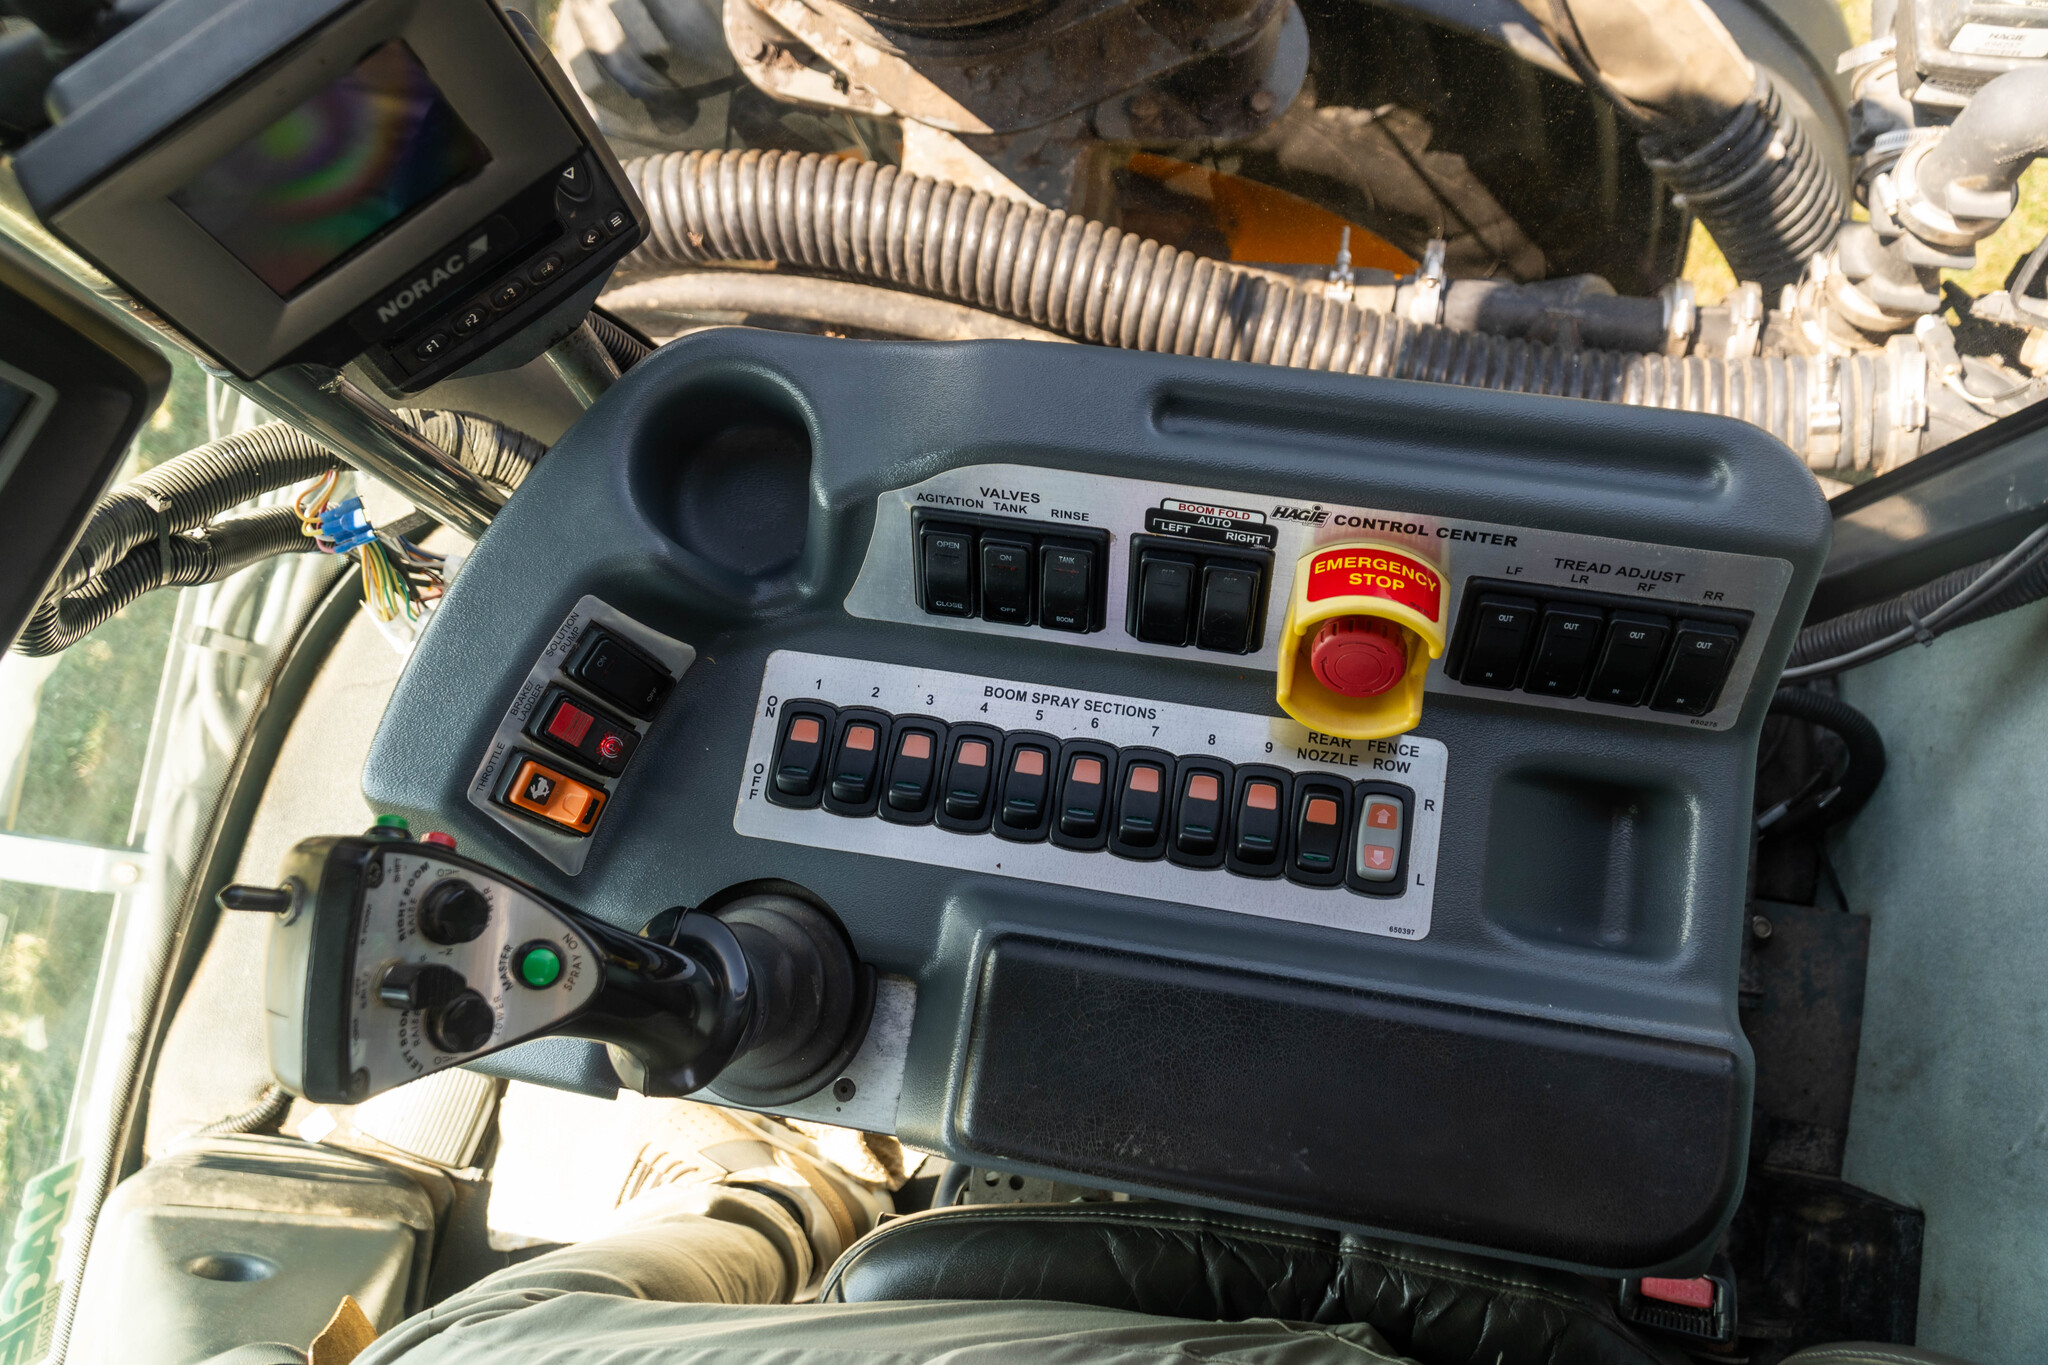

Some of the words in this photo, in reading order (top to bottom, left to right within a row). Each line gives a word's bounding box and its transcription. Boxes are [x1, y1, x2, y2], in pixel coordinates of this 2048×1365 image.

[541, 262, 554, 277] F4
[376, 254, 466, 324] NORAC
[464, 313, 479, 327] F2
[425, 339, 440, 353] F1
[916, 492, 984, 509] AGITATION
[979, 486, 1041, 504] VALVES
[993, 501, 1028, 515] TANK
[1178, 503, 1215, 516] BOOM
[1218, 508, 1251, 521] FOLD
[1050, 509, 1090, 522] RINSE
[1197, 515, 1232, 529] AUTO
[1161, 522, 1191, 535] LEFT
[1334, 514, 1429, 537] CONTROL
[1436, 526, 1518, 548] CENTER
[936, 539, 960, 551] OPEN
[1225, 531, 1263, 545] RIGHT
[999, 554, 1012, 562] ON
[1058, 555, 1075, 565] TANK
[1314, 556, 1437, 593] EMERGENCY
[1505, 565, 1523, 576] LF
[1553, 558, 1611, 575] TREAD
[1615, 566, 1685, 584] ADJUST
[1348, 572, 1405, 591] STOP
[1570, 574, 1589, 584] LR
[1637, 582, 1657, 592] RF
[1703, 590, 1725, 601] RR
[935, 600, 963, 609] CLOSE
[1056, 615, 1074, 624] BOOM
[1498, 614, 1514, 623] OUT
[1563, 622, 1579, 631] OUT
[545, 611, 580, 658] SOLUTION
[559, 626, 581, 654] PUMP
[1629, 631, 1645, 640] OUT
[1696, 641, 1712, 650] OUT
[597, 655, 608, 668] ON
[815, 679, 822, 690] 1
[510, 681, 534, 717] BRAKE/
[872, 686, 881, 698] 2
[517, 684, 544, 723] LADDER
[926, 694, 935, 706] 3
[984, 685, 1027, 703] BOOM
[1031, 692, 1080, 710] SPRAY
[1084, 700, 1157, 720] SECTIONS
[979, 702, 989, 714] 4
[1035, 710, 1044, 721] 5
[1091, 717, 1100, 729] 6
[1151, 725, 1160, 737] 7
[1207, 734, 1216, 746] 8
[1307, 731, 1352, 749] REAR
[1367, 740, 1420, 758] FENCE
[1264, 741, 1274, 754] 9
[475, 743, 506, 793] THROTTLE
[1297, 748, 1359, 767] NOZZLE
[1373, 758, 1411, 774] ROW
[1424, 799, 1435, 812] R
[1416, 873, 1425, 887] L
[397, 900, 407, 942] RIGHT
[403, 861, 431, 896] BOOM
[562, 933, 578, 950] ON
[499, 944, 514, 992] MASTER
[563, 954, 582, 992] SPRAY
